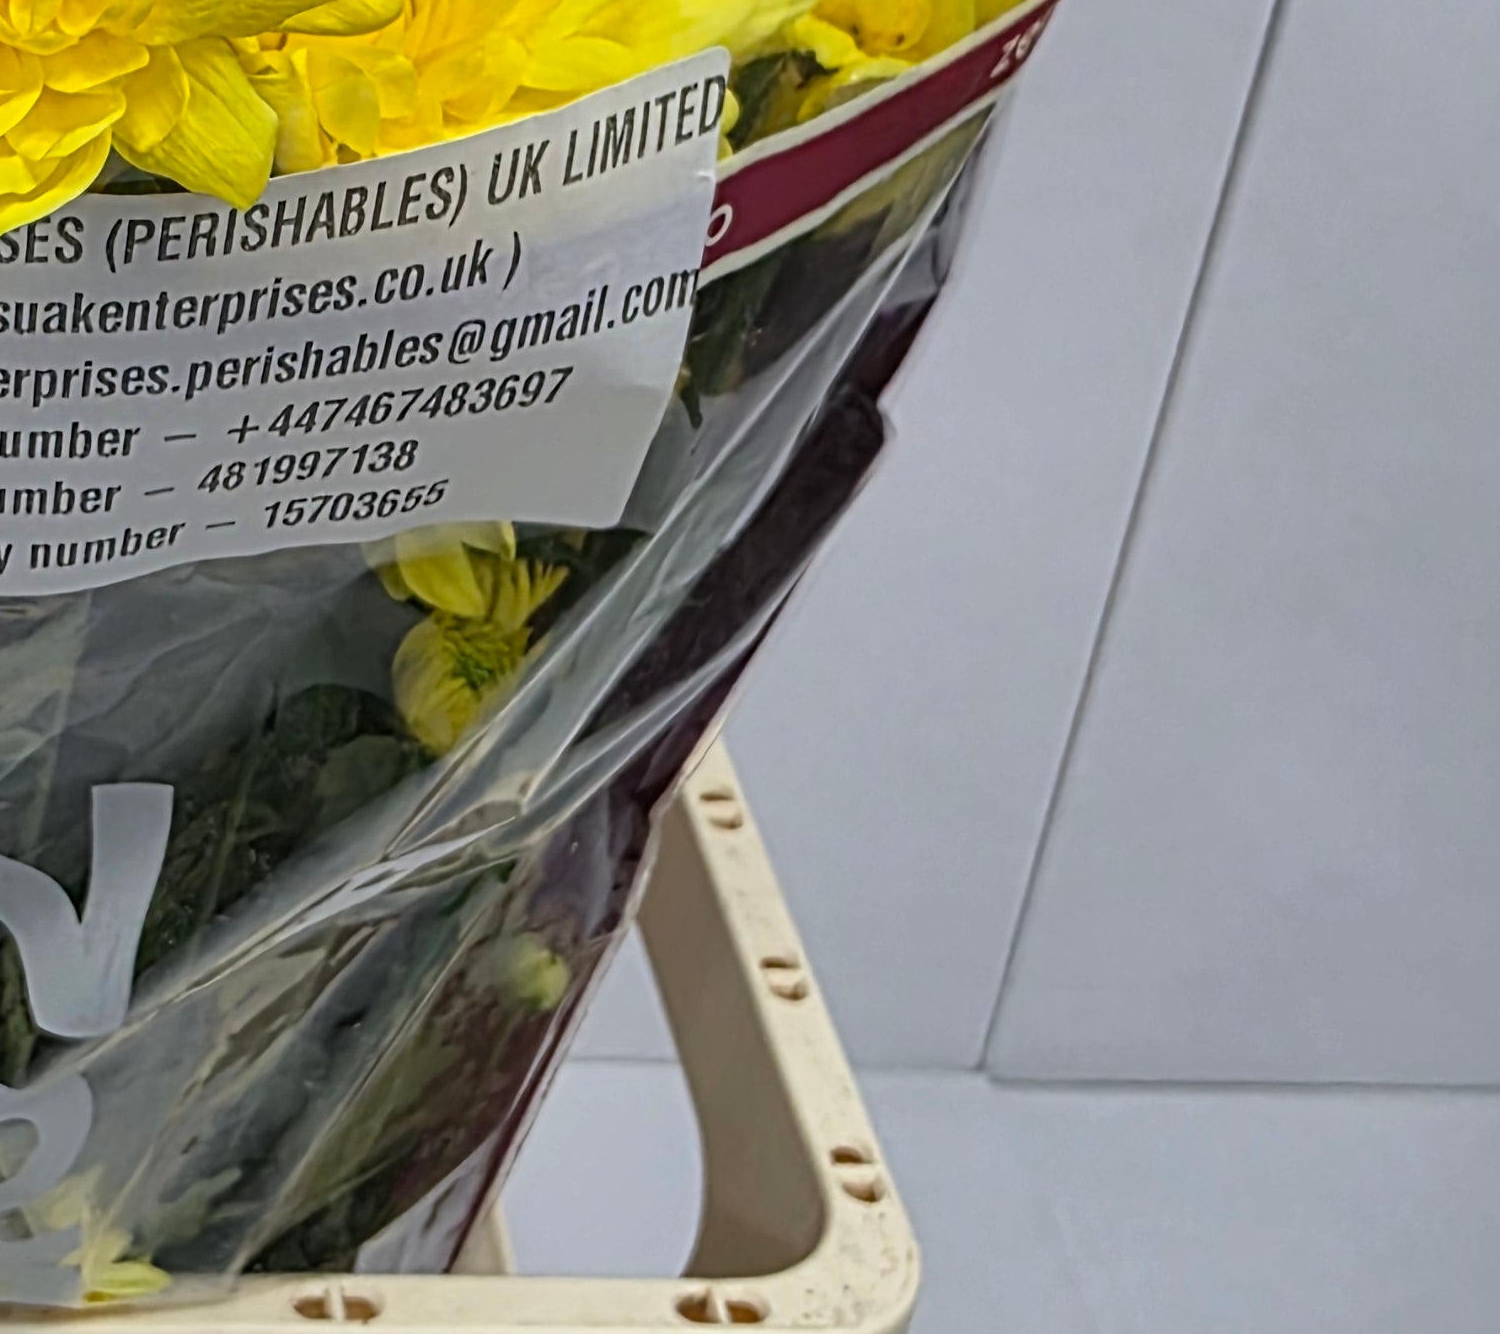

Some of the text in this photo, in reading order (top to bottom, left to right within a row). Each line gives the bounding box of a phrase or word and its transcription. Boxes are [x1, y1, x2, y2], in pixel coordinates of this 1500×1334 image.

[105, 163, 468, 273] (PERISHABLES)
[487, 139, 550, 206] UK
[562, 74, 727, 187] LIMITED
[226, 366, 574, 446] +447467483697
[197, 440, 419, 494] 481997138
[29, 520, 186, 570] number
[263, 479, 450, 530] 15703655
